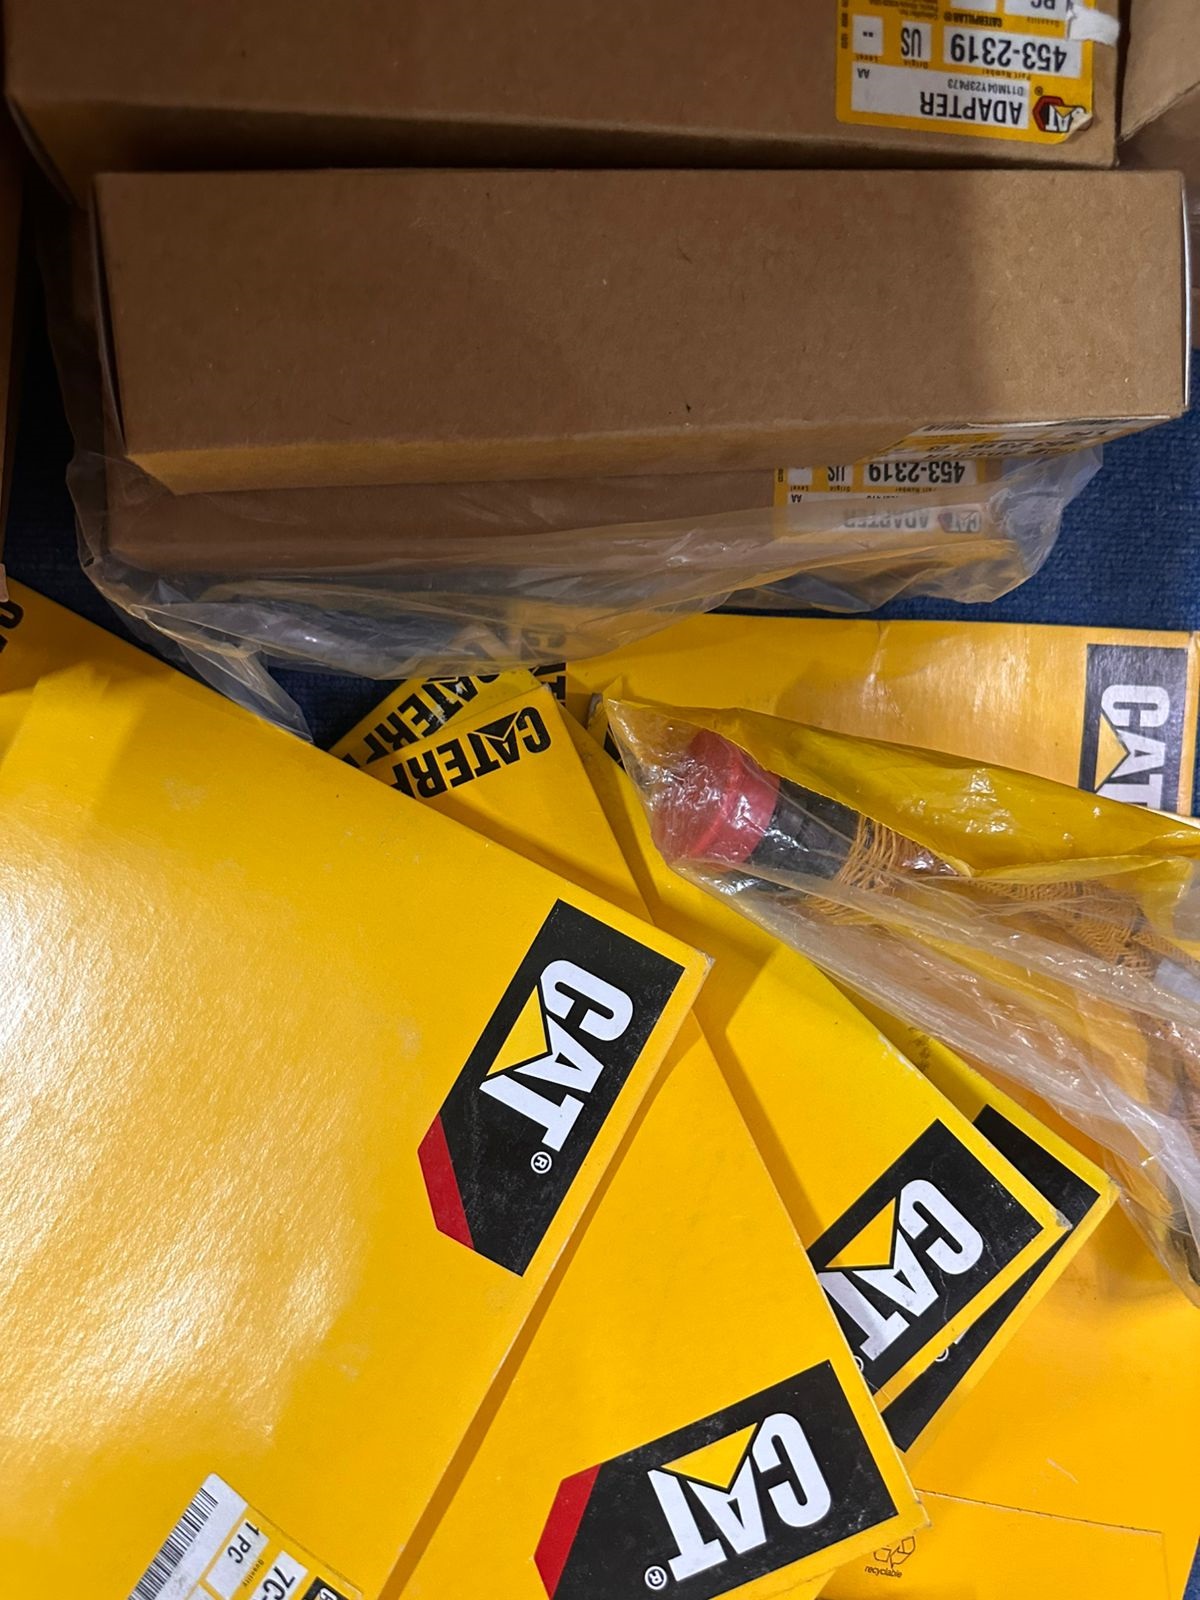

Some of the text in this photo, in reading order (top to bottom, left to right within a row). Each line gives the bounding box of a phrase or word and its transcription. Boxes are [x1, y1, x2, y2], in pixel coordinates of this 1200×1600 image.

[900, 26, 921, 58] US
[950, 33, 1068, 73] 453-2319
[857, 68, 871, 80] AA
[903, 60, 929, 70] Origin
[919, 91, 1024, 125] ADAPTER
[868, 460, 966, 485] 453-2319
[790, 493, 804, 504] AA
[1096, 684, 1171, 810] CAT
[479, 959, 634, 1152] CAT
[817, 1179, 984, 1361] CAT
[647, 1412, 832, 1581] CAT
[227, 1533, 252, 1564] PC
[864, 1565, 903, 1578] recyclable
